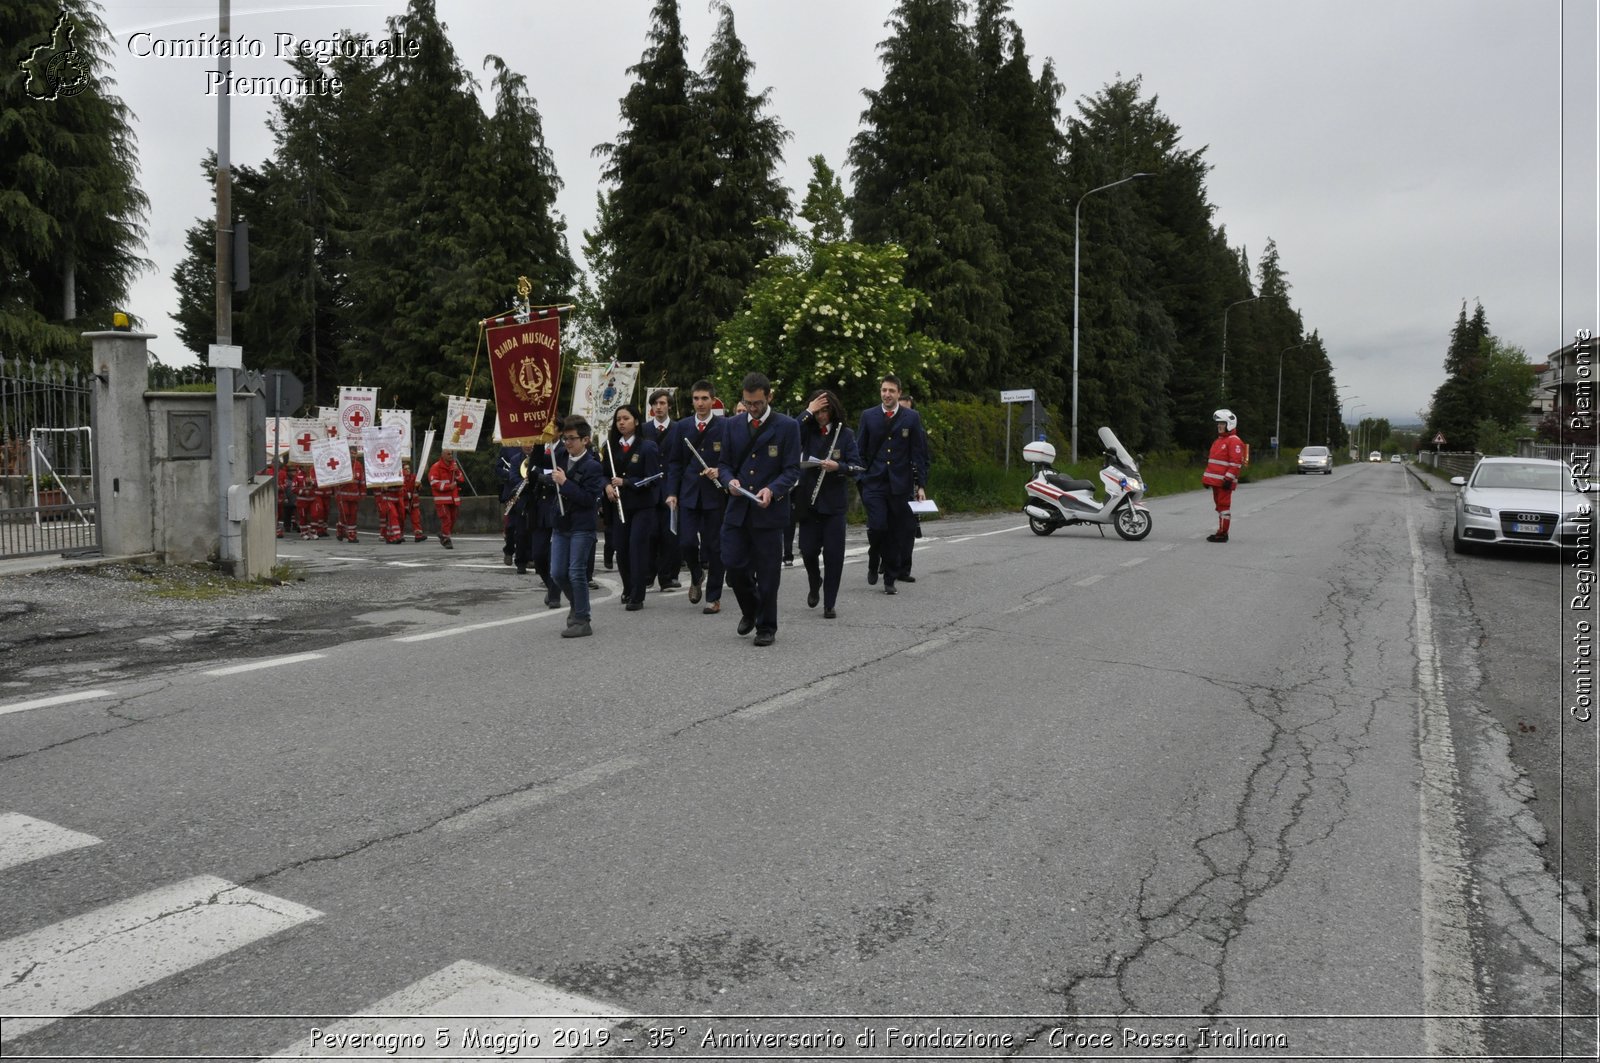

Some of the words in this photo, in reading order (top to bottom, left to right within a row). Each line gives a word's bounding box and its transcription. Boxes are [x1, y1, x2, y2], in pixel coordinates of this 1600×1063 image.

[494, 337, 518, 359] BANDA
[522, 332, 556, 350] MUSICALE
[509, 413, 519, 423] DI
